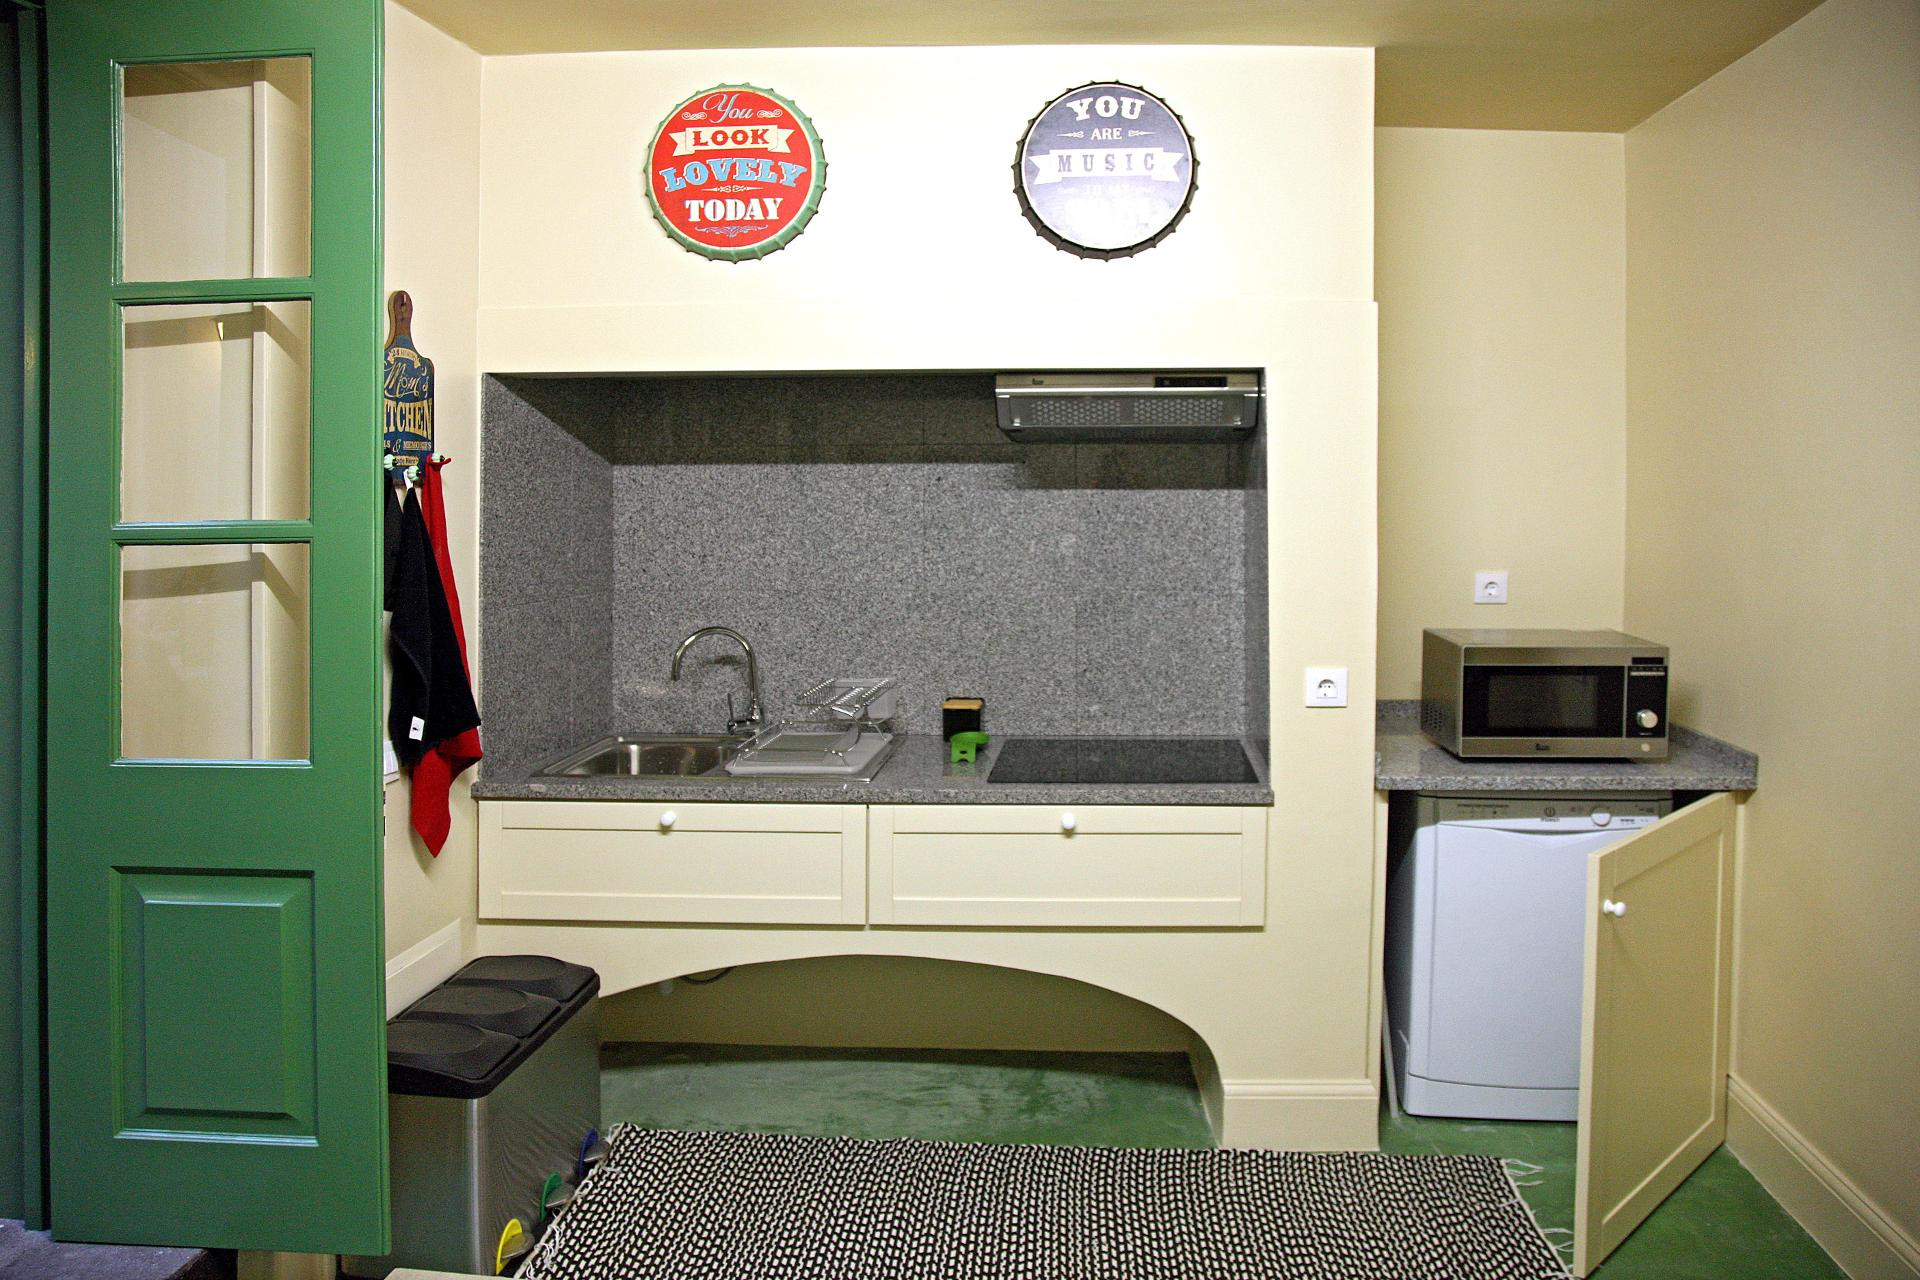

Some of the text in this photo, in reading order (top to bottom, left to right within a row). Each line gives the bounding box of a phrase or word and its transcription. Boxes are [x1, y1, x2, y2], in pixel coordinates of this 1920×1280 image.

[702, 93, 754, 123] You
[1066, 95, 1145, 121] YOU
[692, 128, 770, 147] LOOK
[1090, 127, 1122, 140] ARE
[659, 157, 808, 192] LOVELY
[1057, 153, 1155, 173] MUSIC
[684, 198, 784, 222] TODAY
[384, 397, 433, 442] ITCHEN
